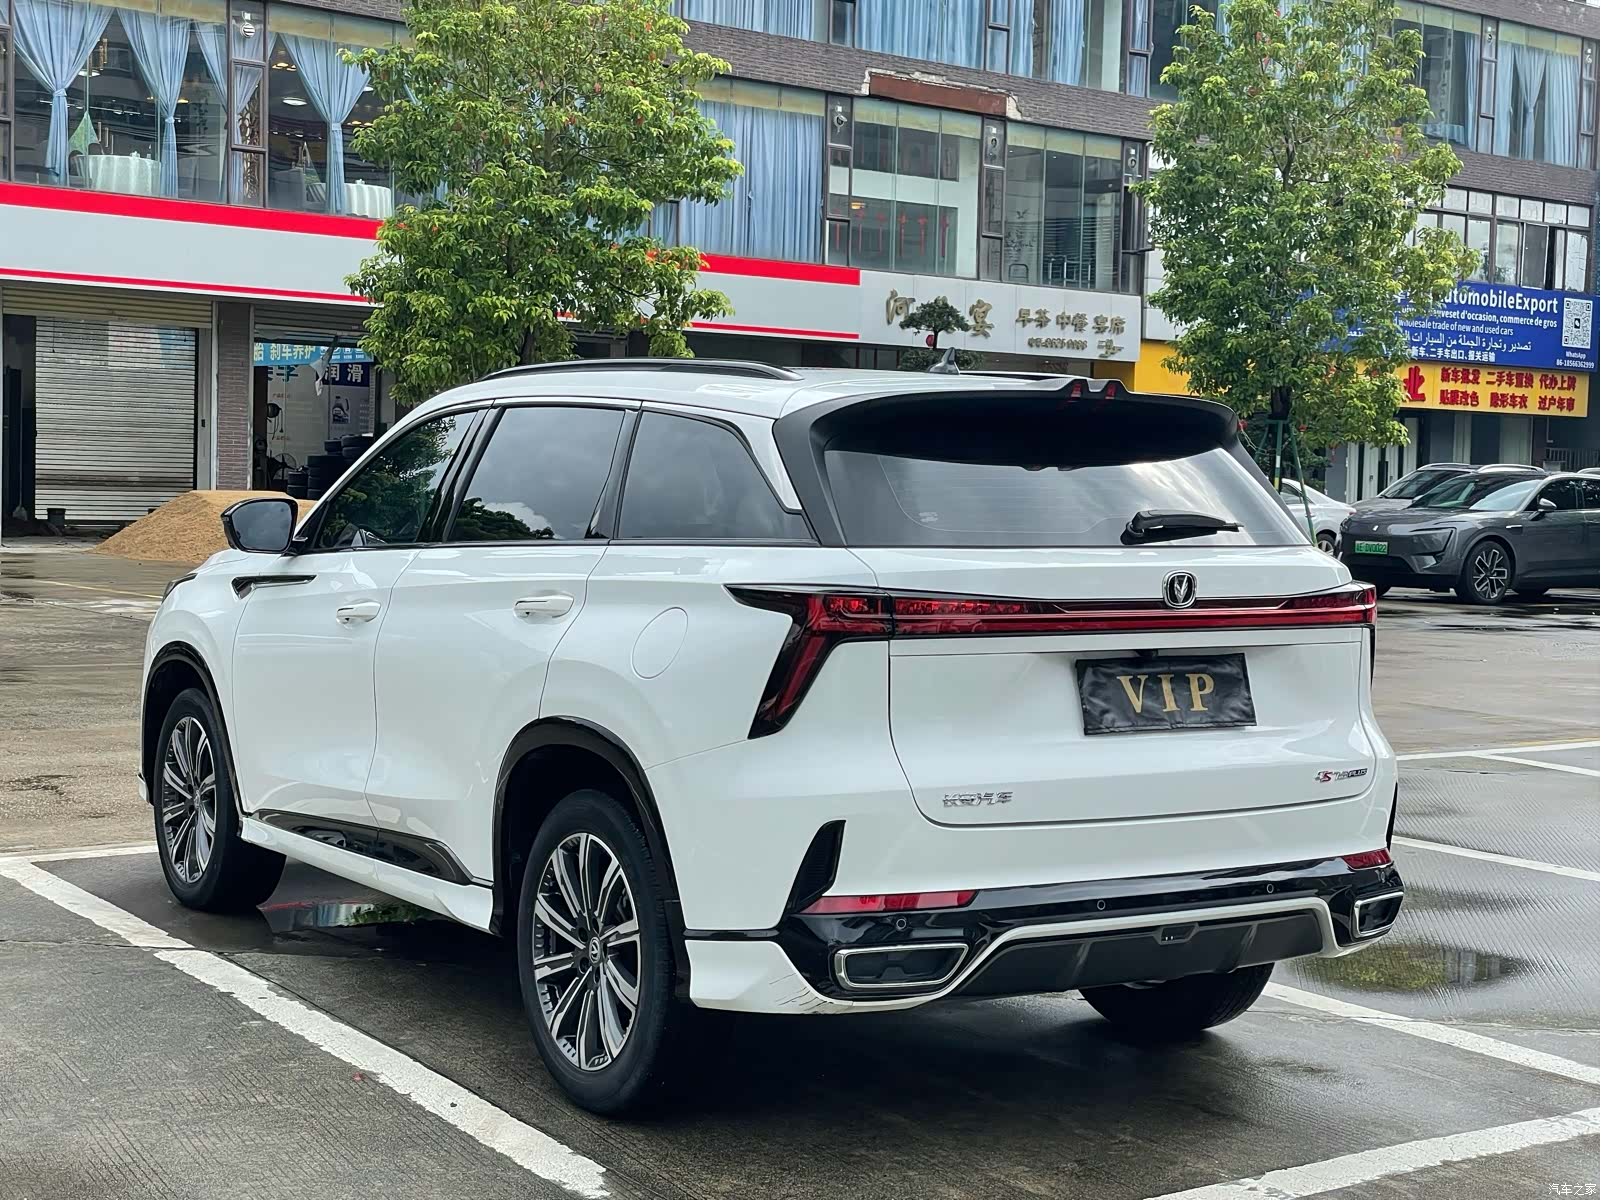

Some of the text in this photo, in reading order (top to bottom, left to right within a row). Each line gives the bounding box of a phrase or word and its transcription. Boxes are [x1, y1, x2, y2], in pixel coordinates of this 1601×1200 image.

[886, 288, 995, 339] 河宴
[1440, 287, 1558, 315] utomobileExport
[1015, 308, 1051, 329] 早茶
[1056, 311, 1088, 333] 中餐
[1432, 321, 1449, 331] trade
[1450, 322, 1457, 331] of
[1458, 324, 1471, 332] new
[1472, 324, 1484, 333] and
[1485, 325, 1499, 335] used
[1500, 328, 1513, 336] cars
[1461, 310, 1499, 324] d'occasion,
[1500, 315, 1533, 326] commerce
[1535, 317, 1542, 326] de
[1543, 320, 1557, 329] gros
[1446, 336, 1457, 347] من
[1116, 673, 1215, 713] VIP
